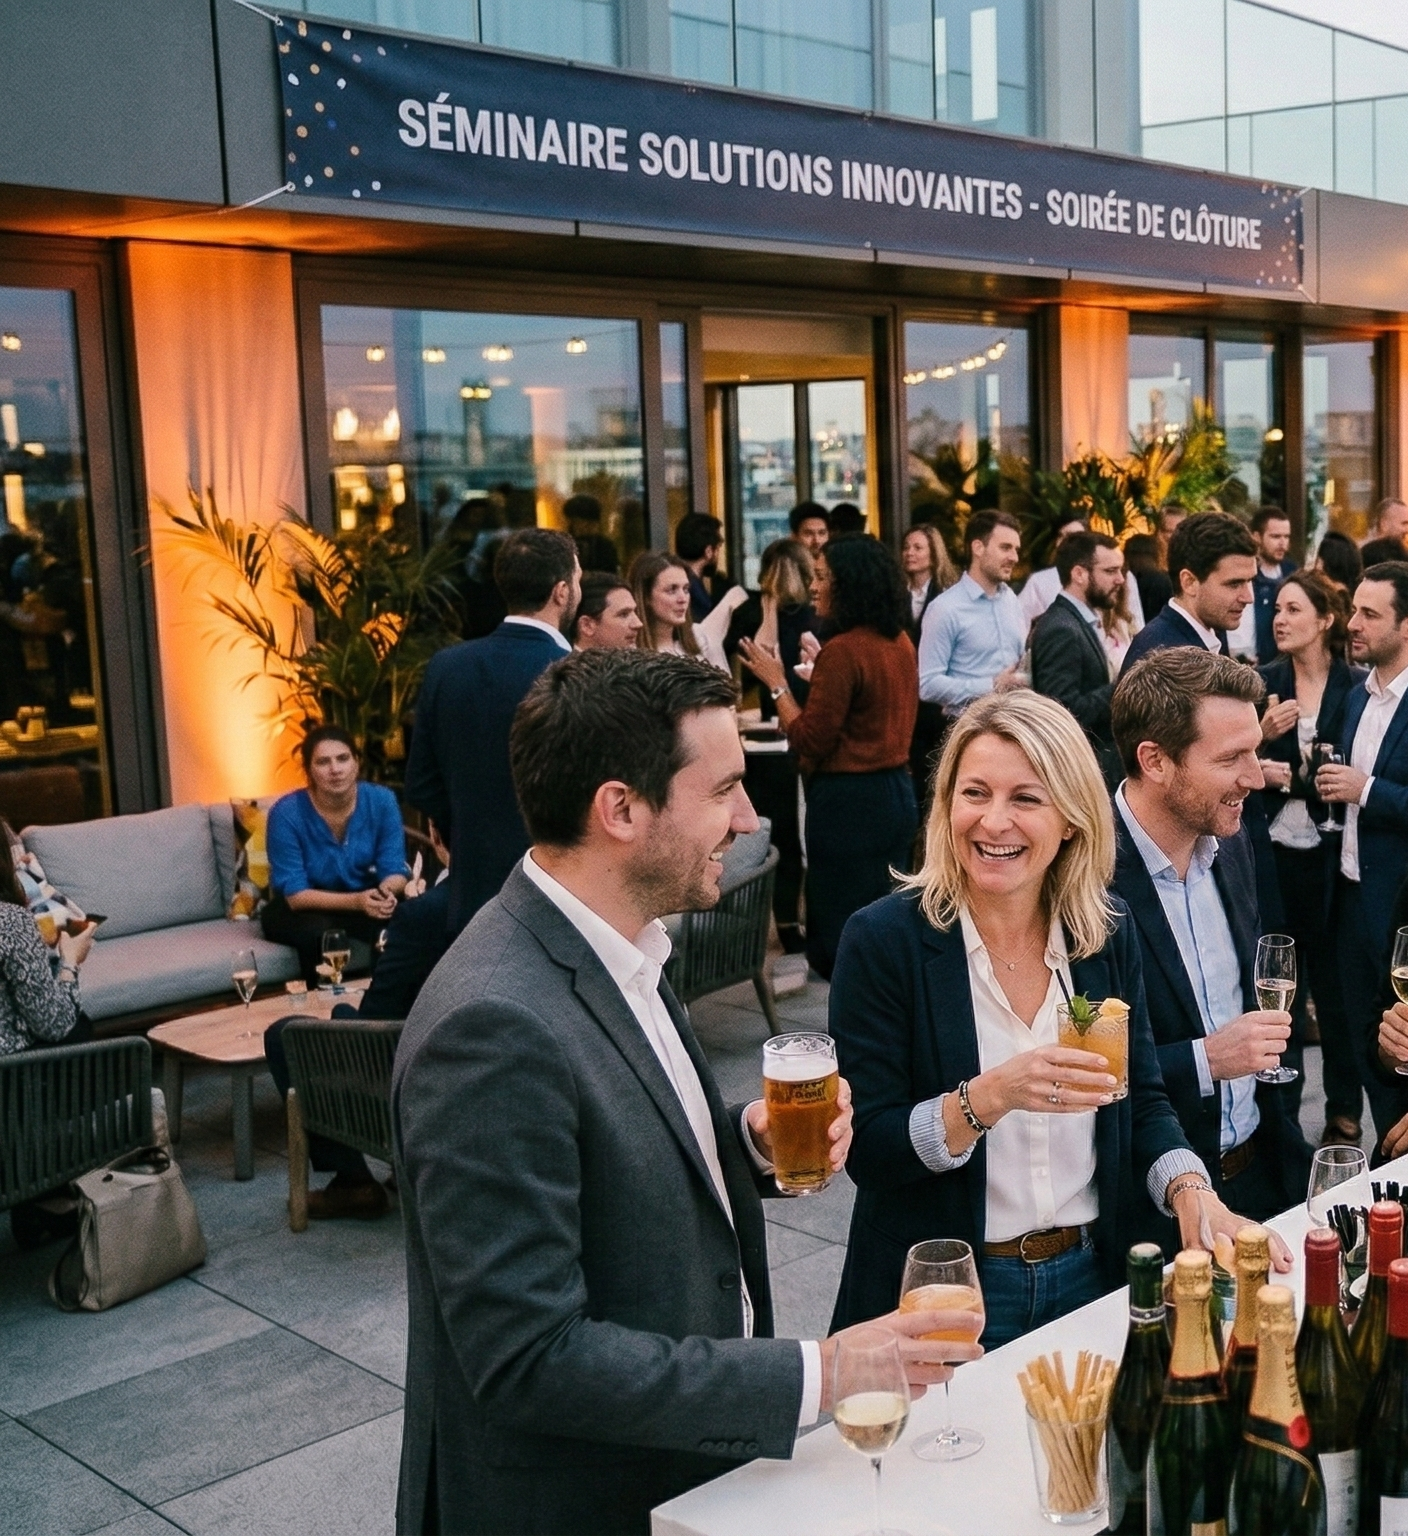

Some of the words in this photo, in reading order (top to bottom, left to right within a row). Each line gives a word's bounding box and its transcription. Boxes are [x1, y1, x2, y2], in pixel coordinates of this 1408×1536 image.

[398, 92, 629, 172] SÉMINAIRE
[639, 131, 834, 197] SOLUTIONS
[841, 160, 1023, 220] INNOVANTES
[1046, 189, 1132, 235] SOIRÉE
[1136, 202, 1166, 239] DE
[1169, 203, 1262, 250] CLÔTURE
